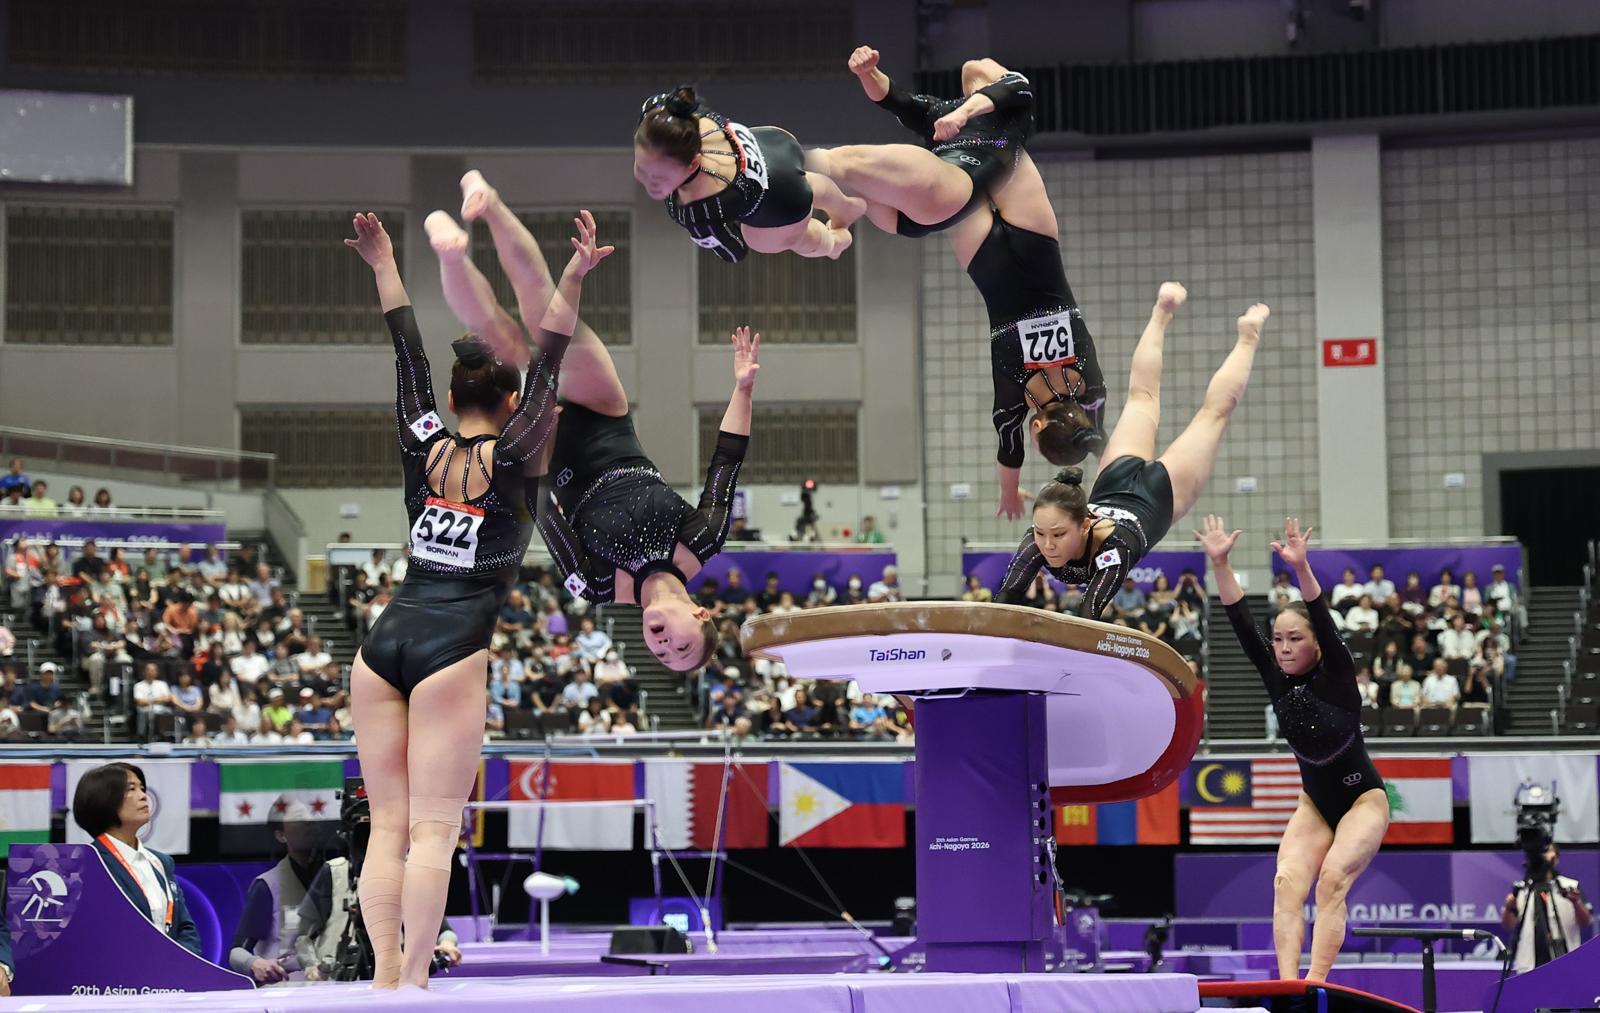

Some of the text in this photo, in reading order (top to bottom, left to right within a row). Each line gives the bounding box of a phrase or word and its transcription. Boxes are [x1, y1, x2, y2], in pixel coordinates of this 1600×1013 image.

[1025, 326, 1069, 362] 522
[416, 507, 474, 550] 522
[426, 545, 459, 558] BORNAN
[869, 648, 926, 662] TaiShan
[1096, 640, 1150, 659] Aichi-Nagoya 2026
[970, 841, 991, 850] 2026
[1420, 903, 1475, 921] ONE
[71, 984, 100, 997] 20th
[103, 984, 138, 997] Asian
